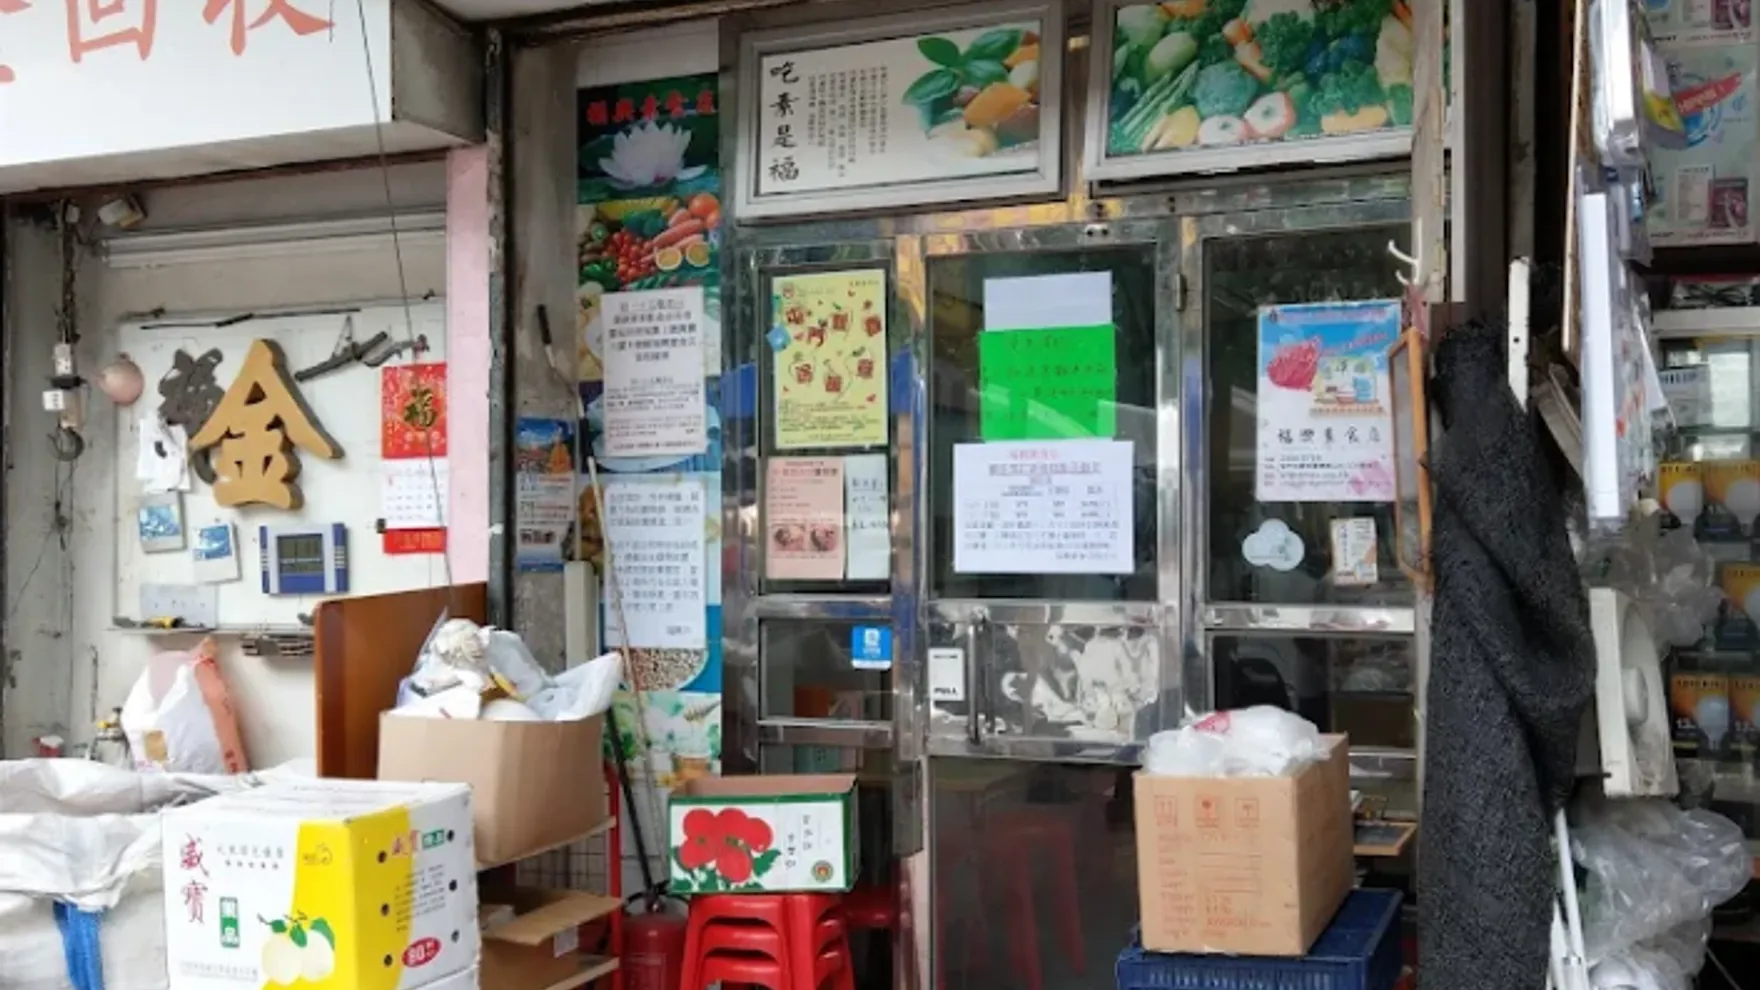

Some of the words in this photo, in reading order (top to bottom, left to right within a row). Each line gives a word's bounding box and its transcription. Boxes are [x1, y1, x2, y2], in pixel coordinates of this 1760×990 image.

[768, 60, 800, 182] 吃素是福
[188, 338, 340, 509] 金
